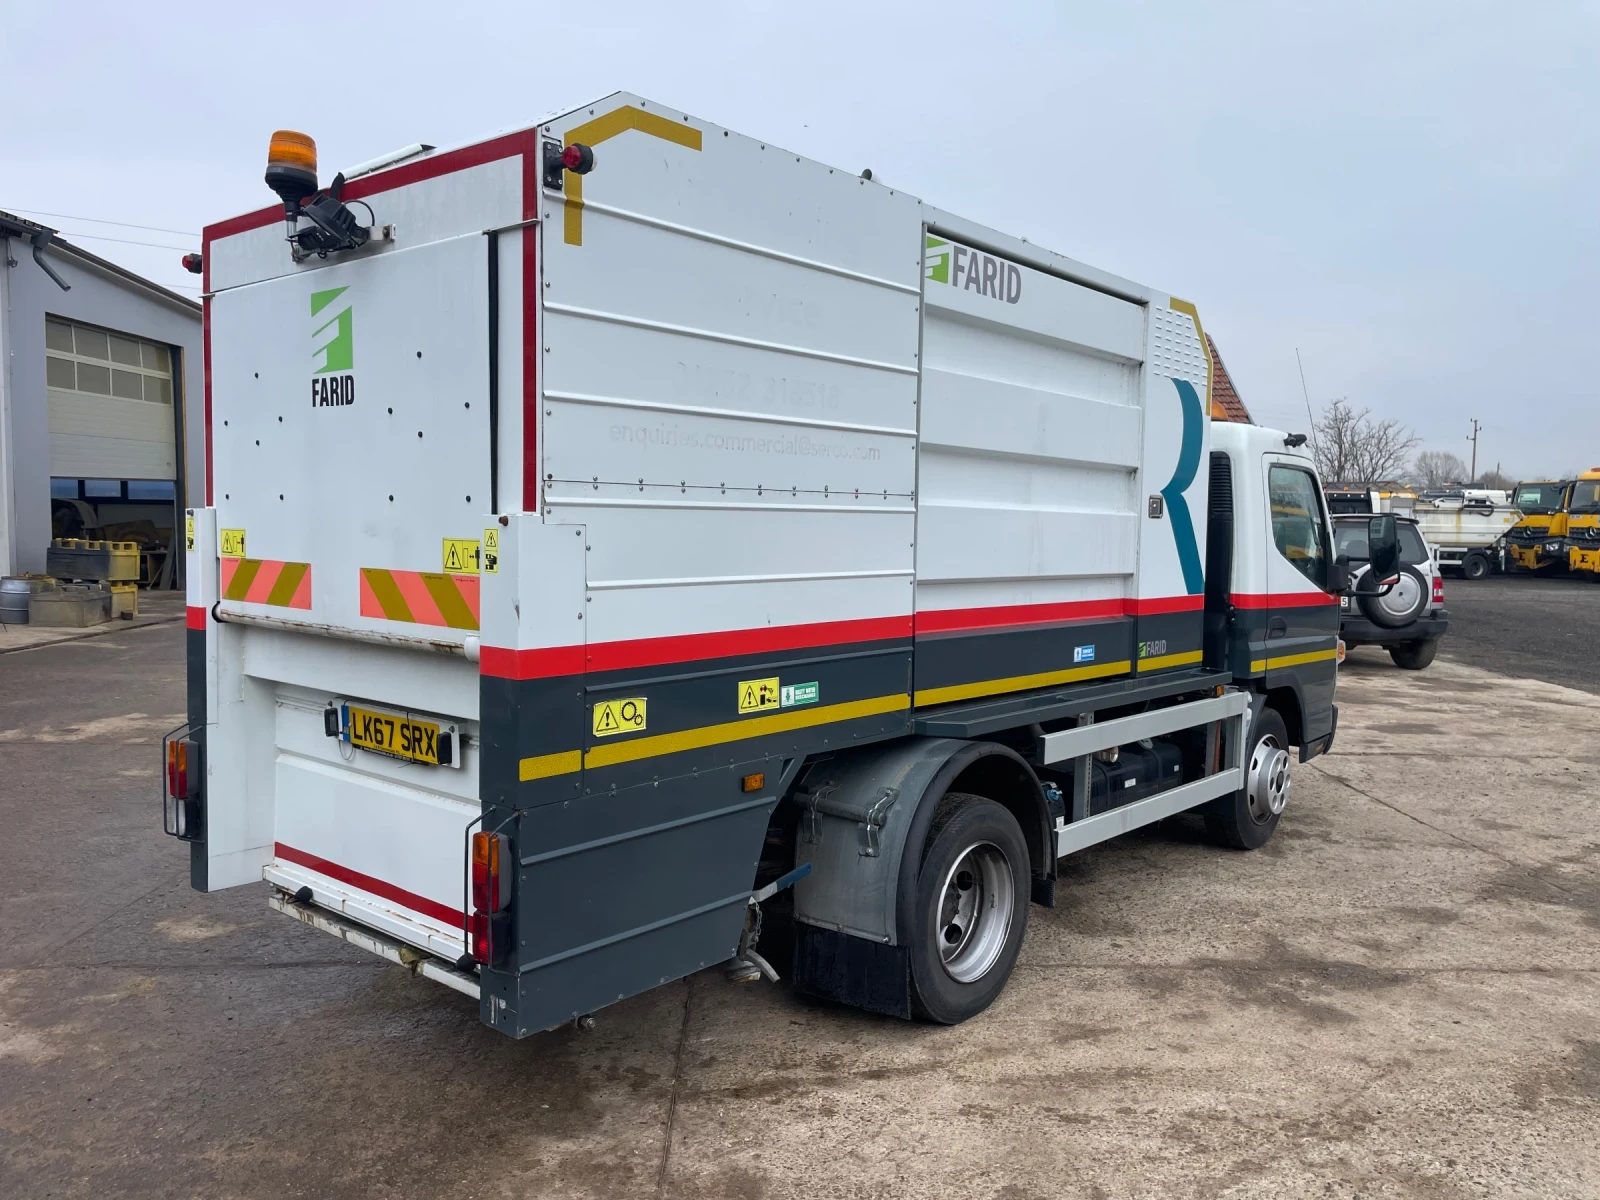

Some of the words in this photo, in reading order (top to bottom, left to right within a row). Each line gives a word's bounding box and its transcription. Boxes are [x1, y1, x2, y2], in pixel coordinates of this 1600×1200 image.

[952, 245, 1022, 305] FARID
[312, 374, 355, 407] FARID
[1146, 640, 1167, 656] FARID
[352, 712, 395, 748] LK67
[400, 723, 436, 758] SRX
